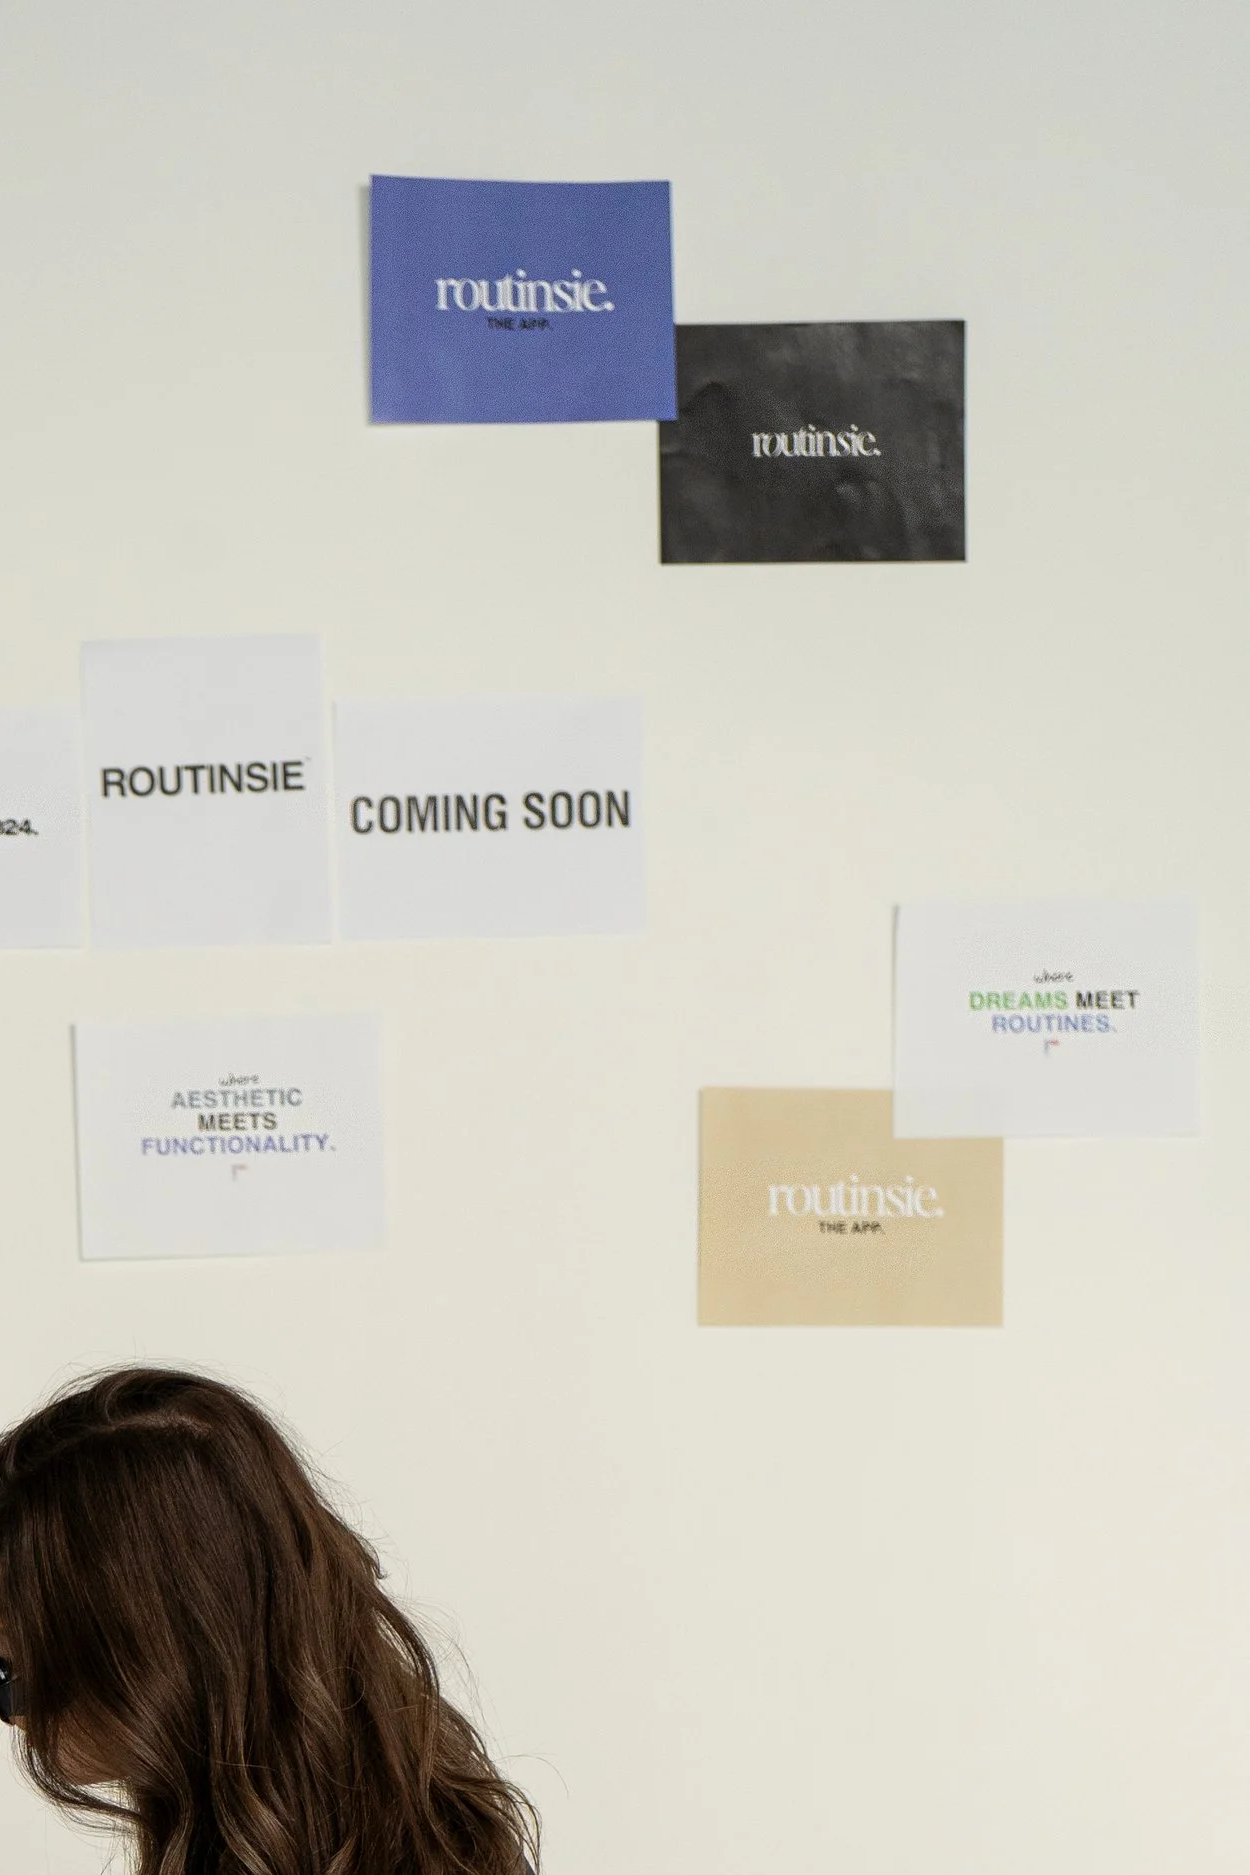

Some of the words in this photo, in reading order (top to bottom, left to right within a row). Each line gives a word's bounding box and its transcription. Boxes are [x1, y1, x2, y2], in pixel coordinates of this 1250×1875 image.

[436, 269, 615, 312] routinsie.
[487, 317, 514, 331] THE
[751, 425, 881, 457] routinsie.
[351, 792, 507, 834] COMING
[524, 790, 631, 830] SOON
[969, 991, 1068, 1011] DREAMS
[1076, 990, 1139, 1010] MEET
[992, 1014, 1117, 1034] ROUTINES.
[219, 1074, 260, 1087] where
[171, 1089, 303, 1109] AESTHETIC
[199, 1112, 277, 1132] MEETS
[141, 1134, 336, 1156] FUNCTIONALITY.
[768, 1174, 945, 1217] routinsie.
[818, 1221, 847, 1235] THE
